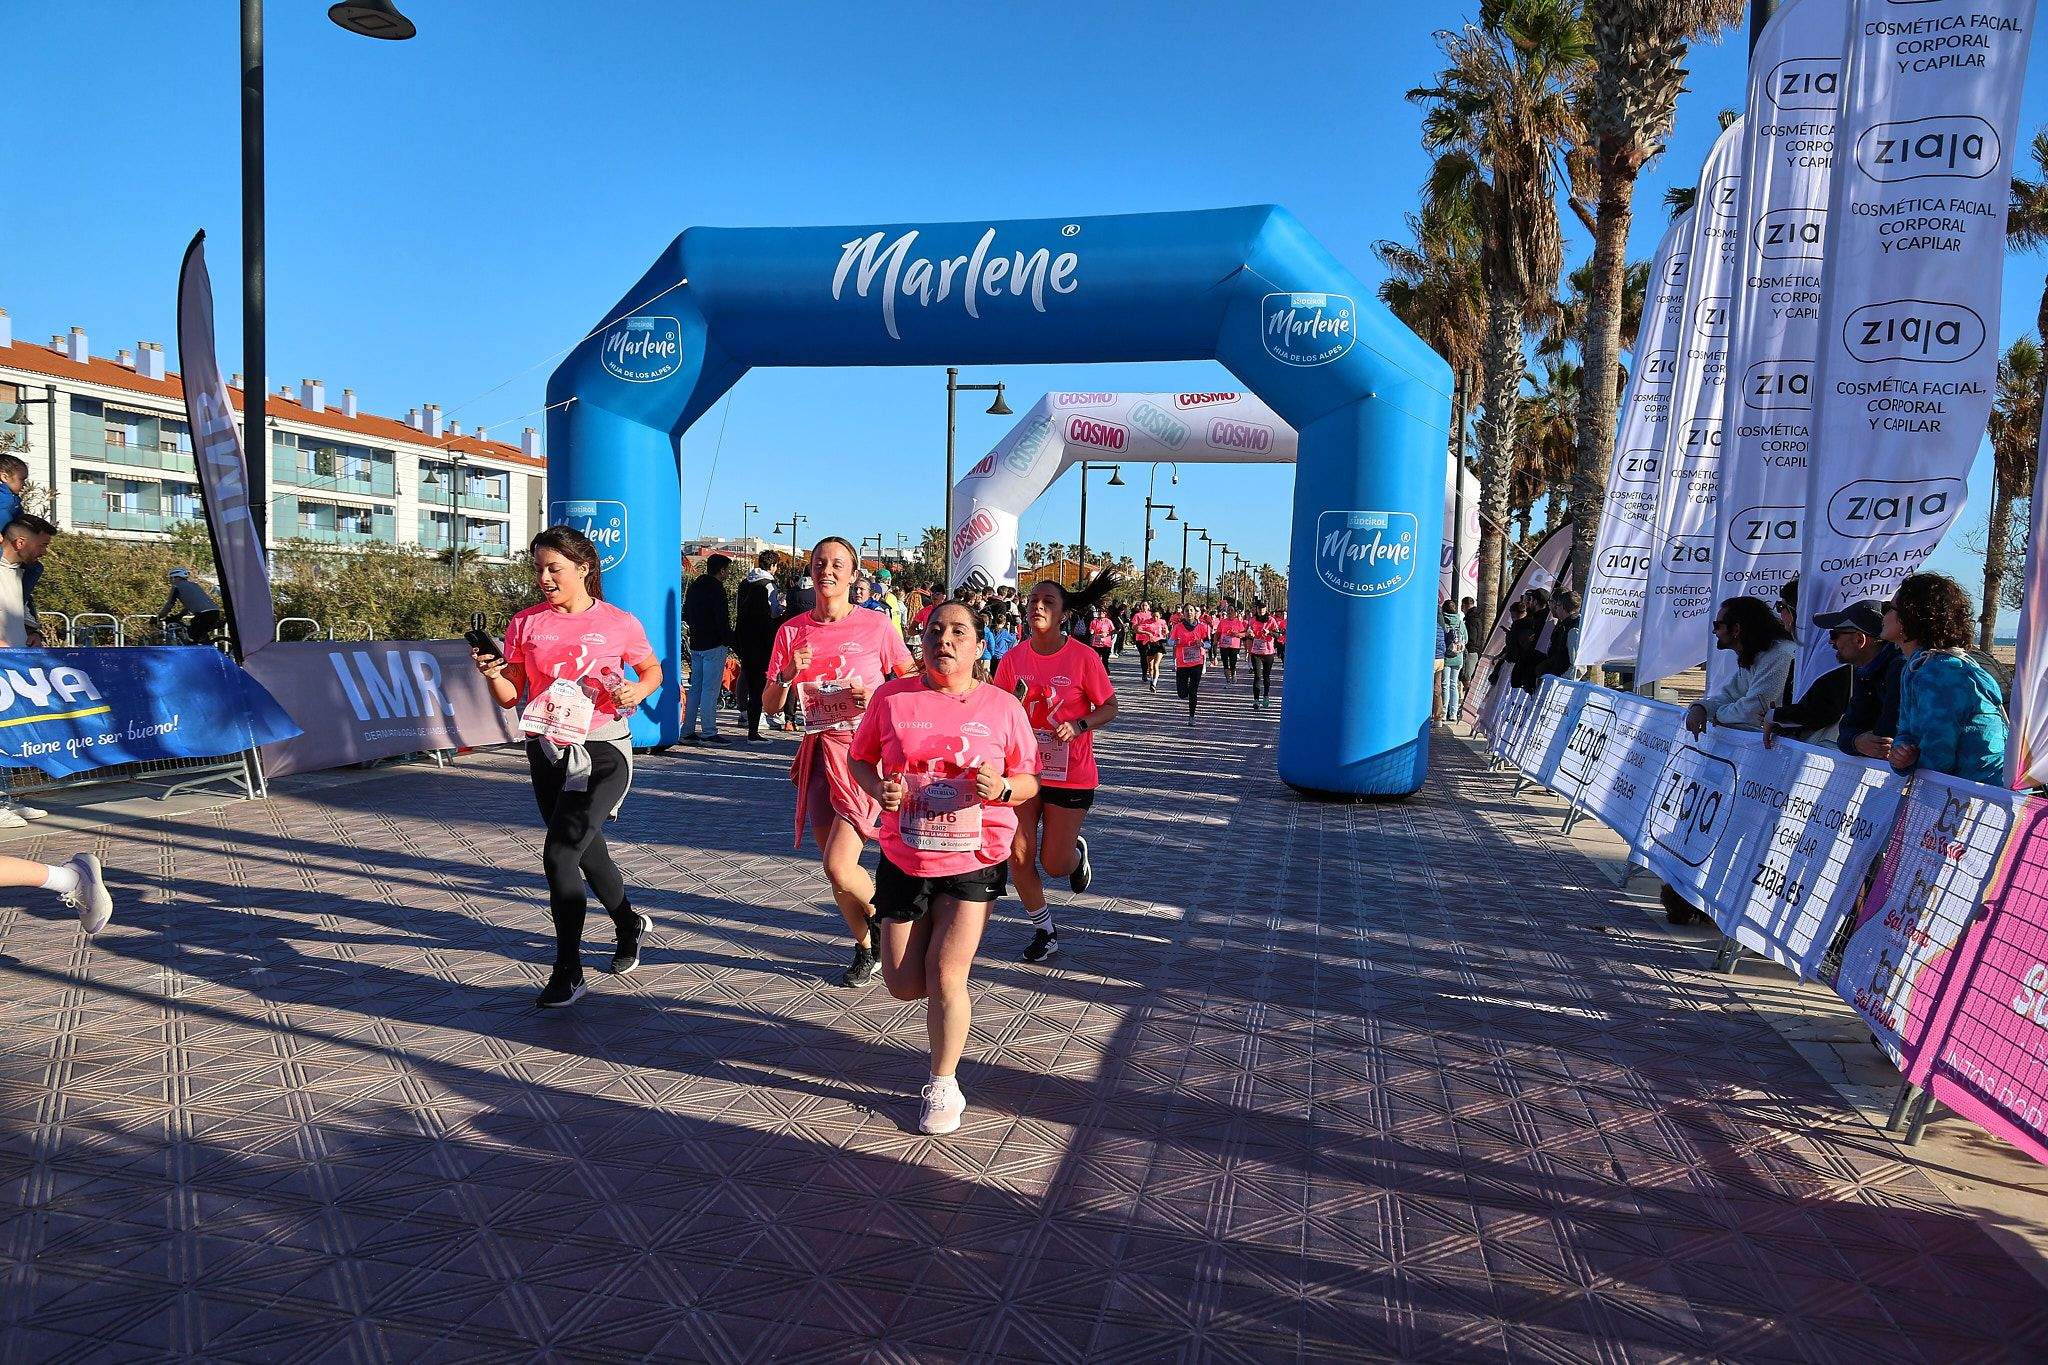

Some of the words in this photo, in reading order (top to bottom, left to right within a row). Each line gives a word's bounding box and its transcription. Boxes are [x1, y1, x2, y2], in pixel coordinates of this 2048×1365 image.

[1865, 15, 1965, 36] COSMÉTICA
[1970, 14, 2022, 34] FACIAL,
[1895, 34, 1990, 55] CORPORAL
[1898, 61, 1909, 74] Y
[1913, 54, 1986, 73] CAPILAR
[1874, 133, 1984, 169] ziaja
[1787, 157, 1796, 167] Y
[1851, 197, 1945, 217] COSMÉTICA
[1949, 199, 1997, 219] FACIAL,
[1879, 217, 1966, 236] CORPORAL
[1881, 241, 1894, 254] Y
[1896, 236, 1961, 253] CAPILAR
[1748, 274, 1820, 289] COSMÉTICA
[1773, 309, 1782, 319] Y
[1859, 317, 1961, 355] ziaja
[1273, 345, 1288, 359] HIJA
[1319, 344, 1343, 360] ALPES
[609, 362, 623, 374] HIJA
[624, 370, 634, 378] DE
[651, 364, 672, 377] ALPES
[1836, 376, 1919, 395] COSMÉTICA
[1922, 382, 1987, 395] FACIAL,
[1867, 399, 1947, 414] CORPORAL
[1070, 418, 1125, 449] COSMO
[1132, 402, 1186, 446] COSMO
[1737, 423, 1809, 437] COSMÉTICA
[1868, 417, 1879, 430] Y
[1883, 417, 1942, 433] CAPILAR
[1211, 421, 1269, 451] COSMO
[1763, 457, 1772, 467] Y
[952, 513, 993, 559] COSMO
[1325, 570, 1341, 586] HIJA
[1343, 581, 1355, 590] DE
[1357, 584, 1374, 592] LOS
[1376, 575, 1402, 591] ALPES
[1724, 568, 1800, 582] COSMÉTICA
[328, 650, 455, 721] IMR
[66, 735, 94, 758] que
[98, 731, 123, 745] ser
[128, 714, 180, 740] bueno!
[1661, 772, 1723, 845] ziaja
[1742, 780, 1789, 812] COSMÉTICA
[1790, 795, 1822, 825] FACIAL,
[926, 810, 957, 823] 016
[1771, 822, 1781, 842] Y
[1779, 829, 1819, 859] CAPILAR
[1751, 858, 1805, 907] ziaja.es
